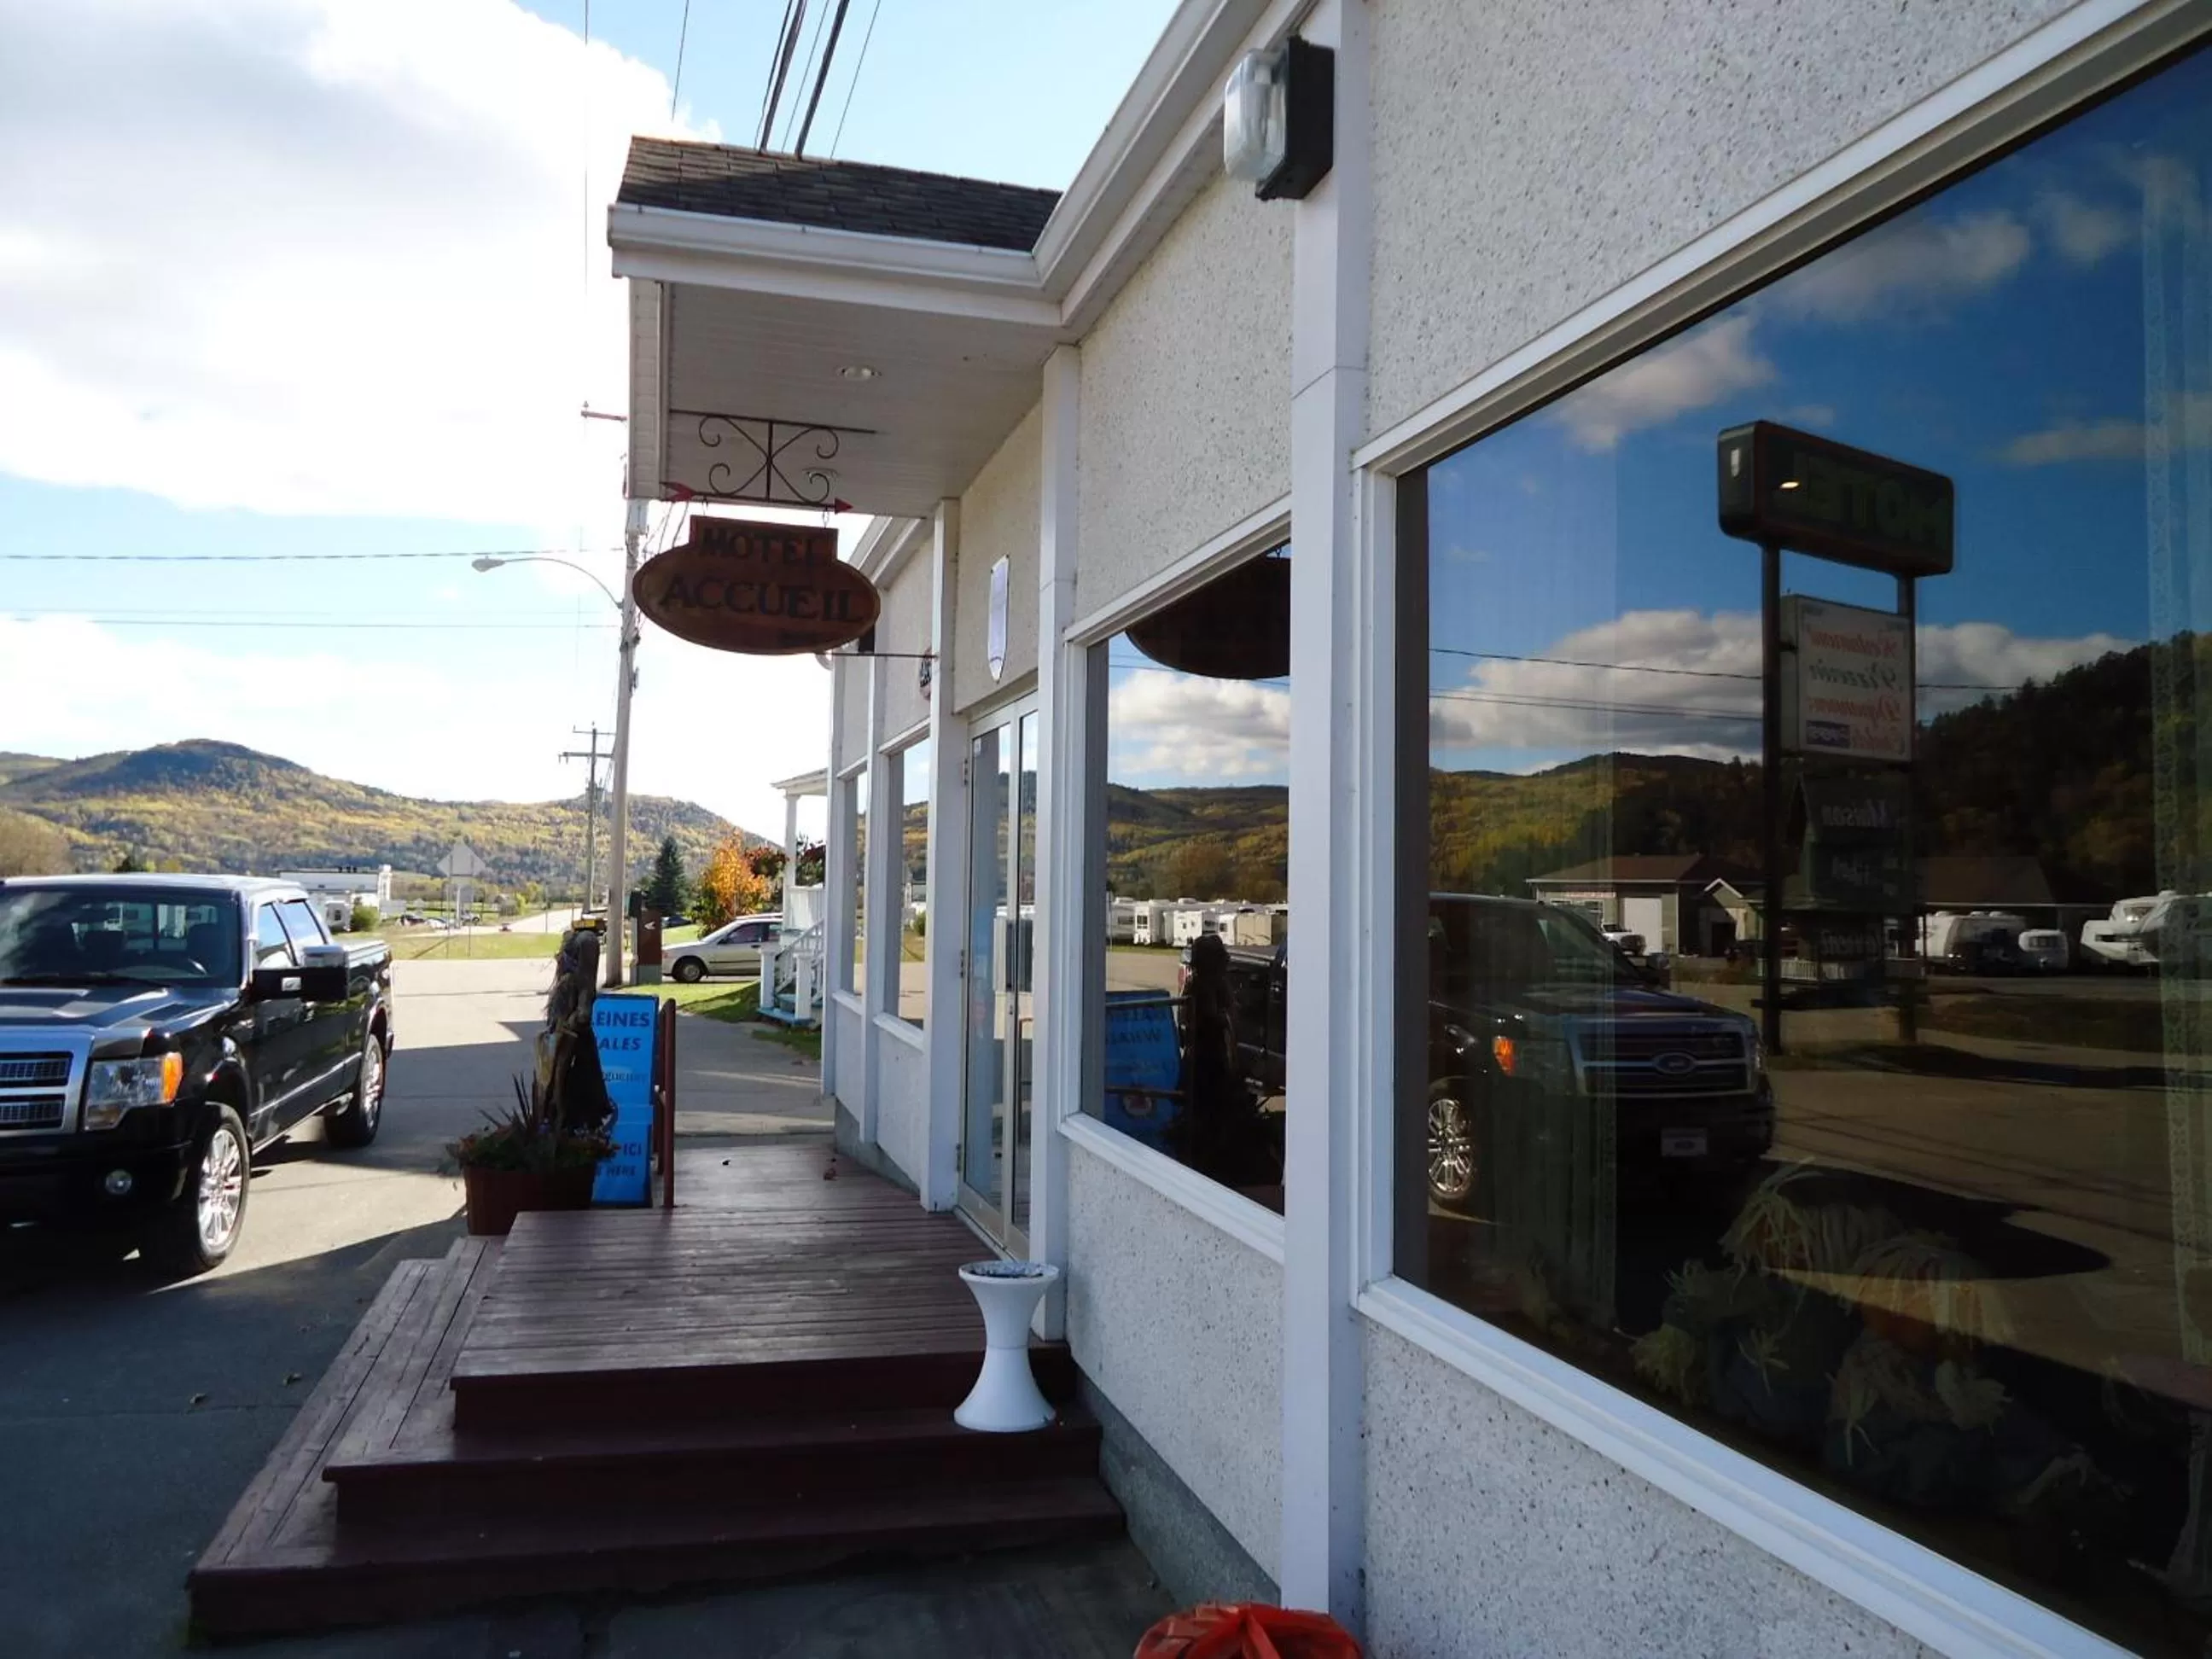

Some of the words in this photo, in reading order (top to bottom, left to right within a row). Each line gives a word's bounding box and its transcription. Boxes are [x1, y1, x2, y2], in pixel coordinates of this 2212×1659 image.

[699, 526, 833, 567] MOTEL
[658, 573, 864, 622] ACCUEIL
[596, 1010, 650, 1027] EINES
[598, 1037, 642, 1051] ALES
[623, 1143, 642, 1155] ICI
